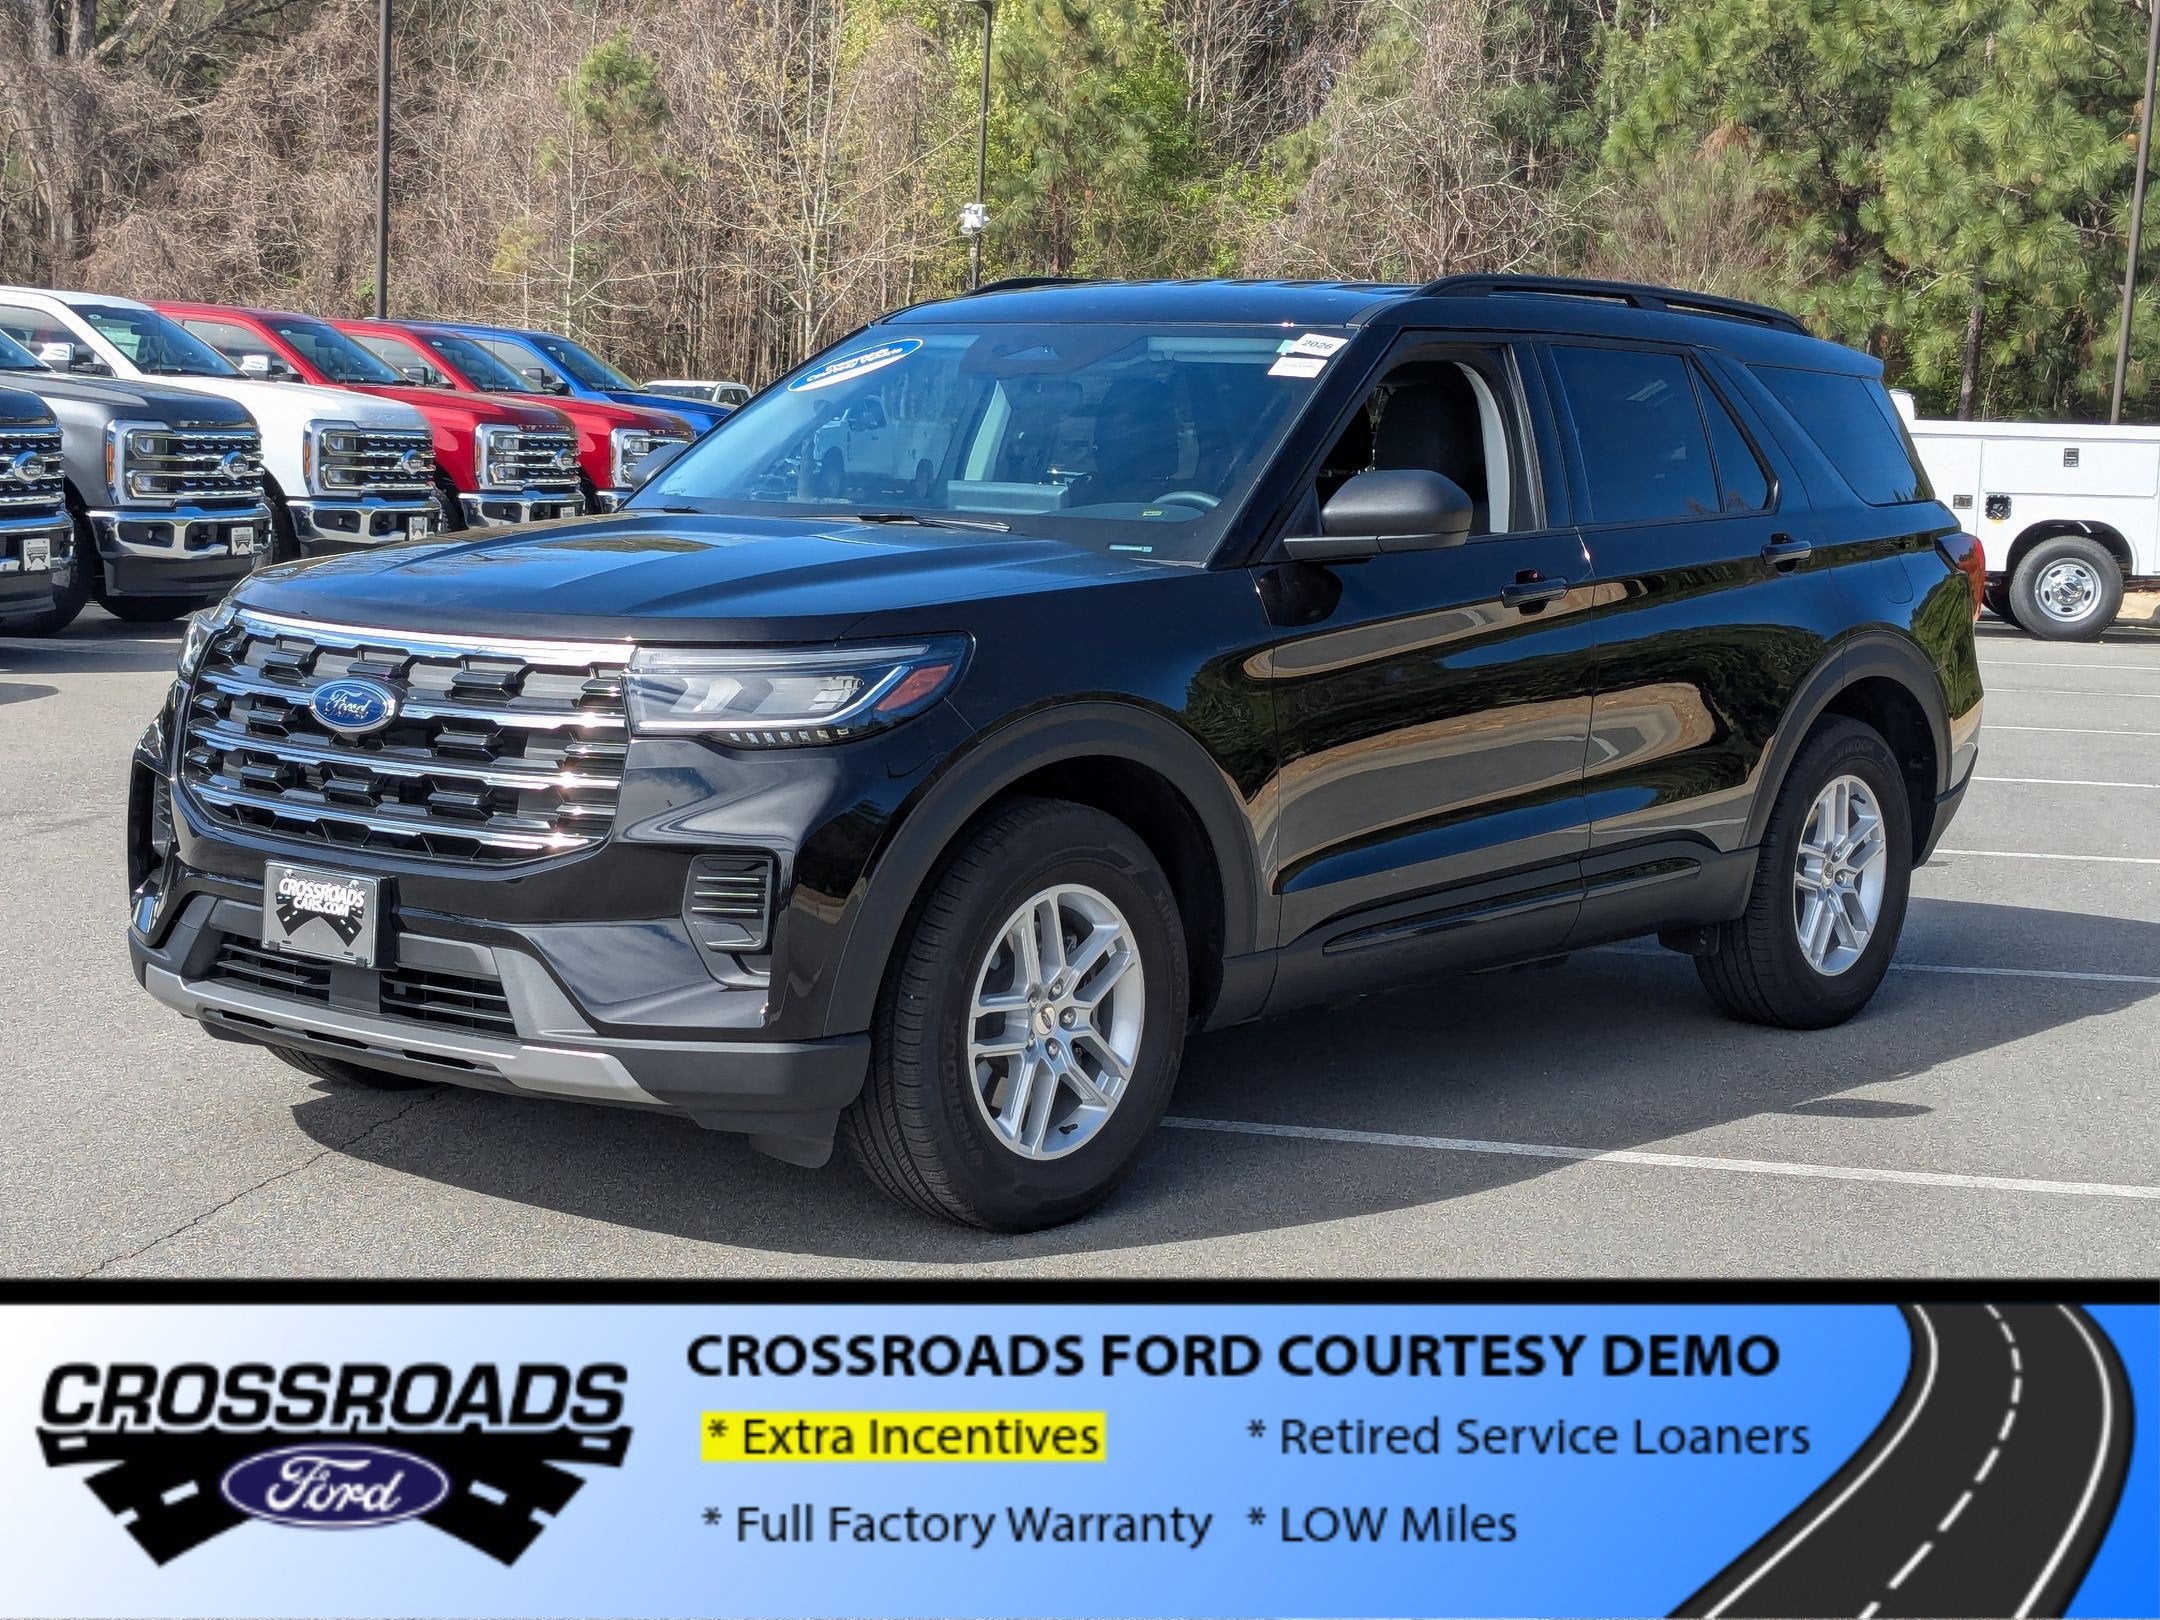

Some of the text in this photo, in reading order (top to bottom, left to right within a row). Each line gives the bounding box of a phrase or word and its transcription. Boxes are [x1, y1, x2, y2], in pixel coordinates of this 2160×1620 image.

[1302, 340, 1335, 350] 2026
[324, 688, 373, 719] Ford
[279, 877, 366, 908] CROSSROADS
[293, 896, 350, 918] CARS.COM
